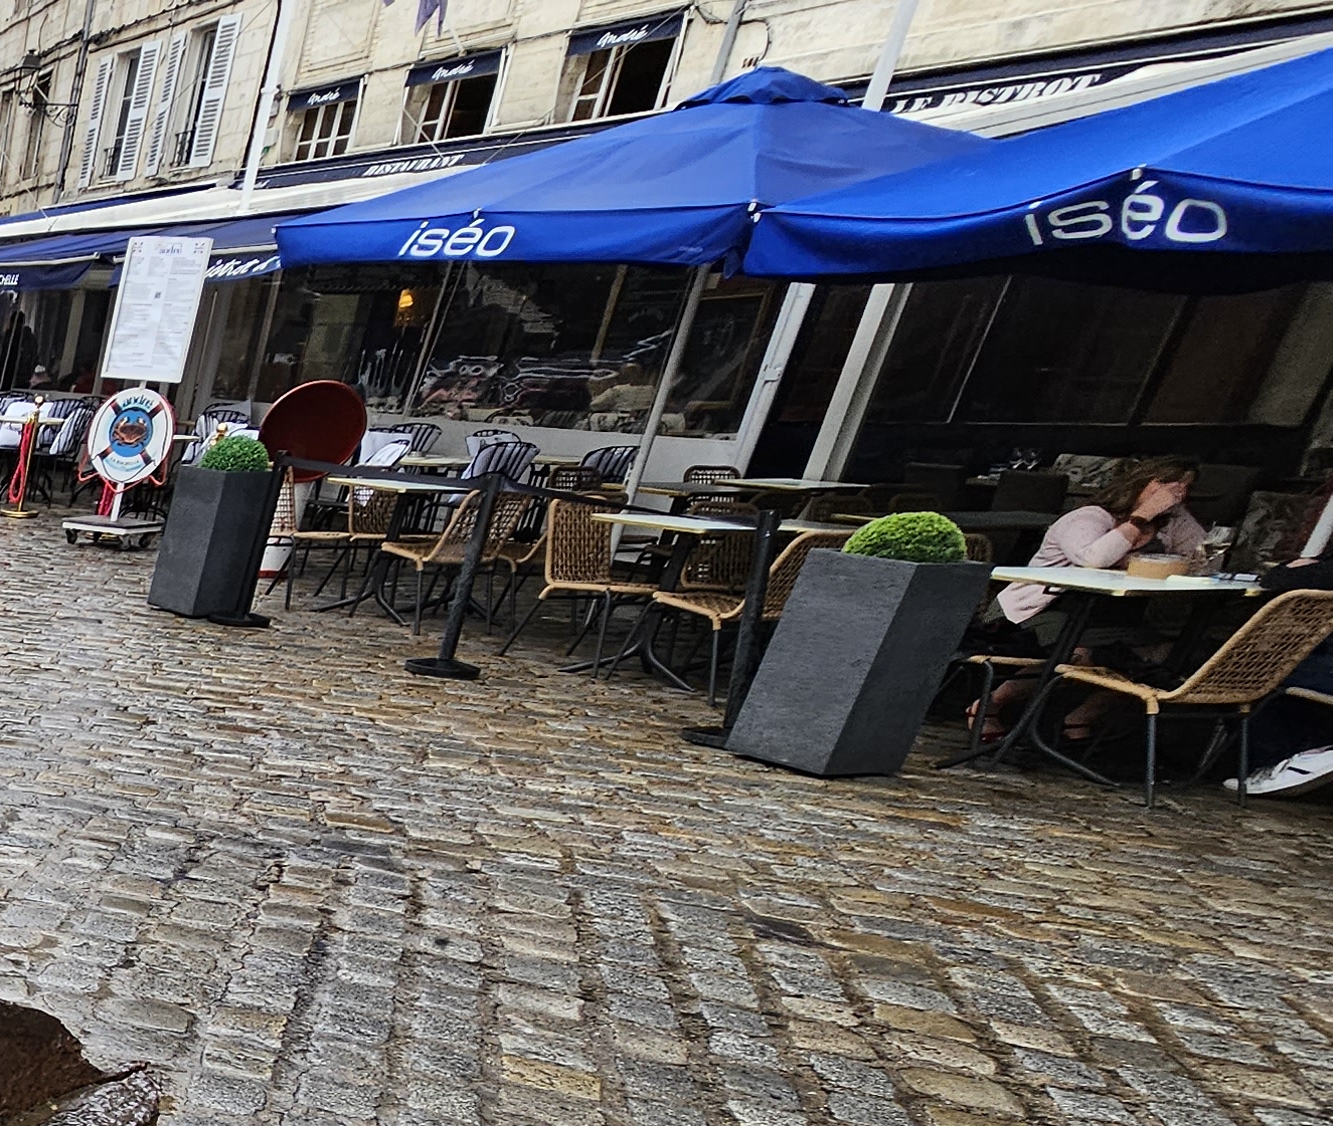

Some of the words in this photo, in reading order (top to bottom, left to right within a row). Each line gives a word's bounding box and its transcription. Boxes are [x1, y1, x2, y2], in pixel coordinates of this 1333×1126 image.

[889, 97, 933, 114] LE
[938, 73, 1101, 108] BISTROT
[361, 154, 465, 177] RESTAURANT
[1024, 181, 1228, 246] iséo
[398, 218, 516, 257] iséo
[205, 259, 260, 278] istrot
